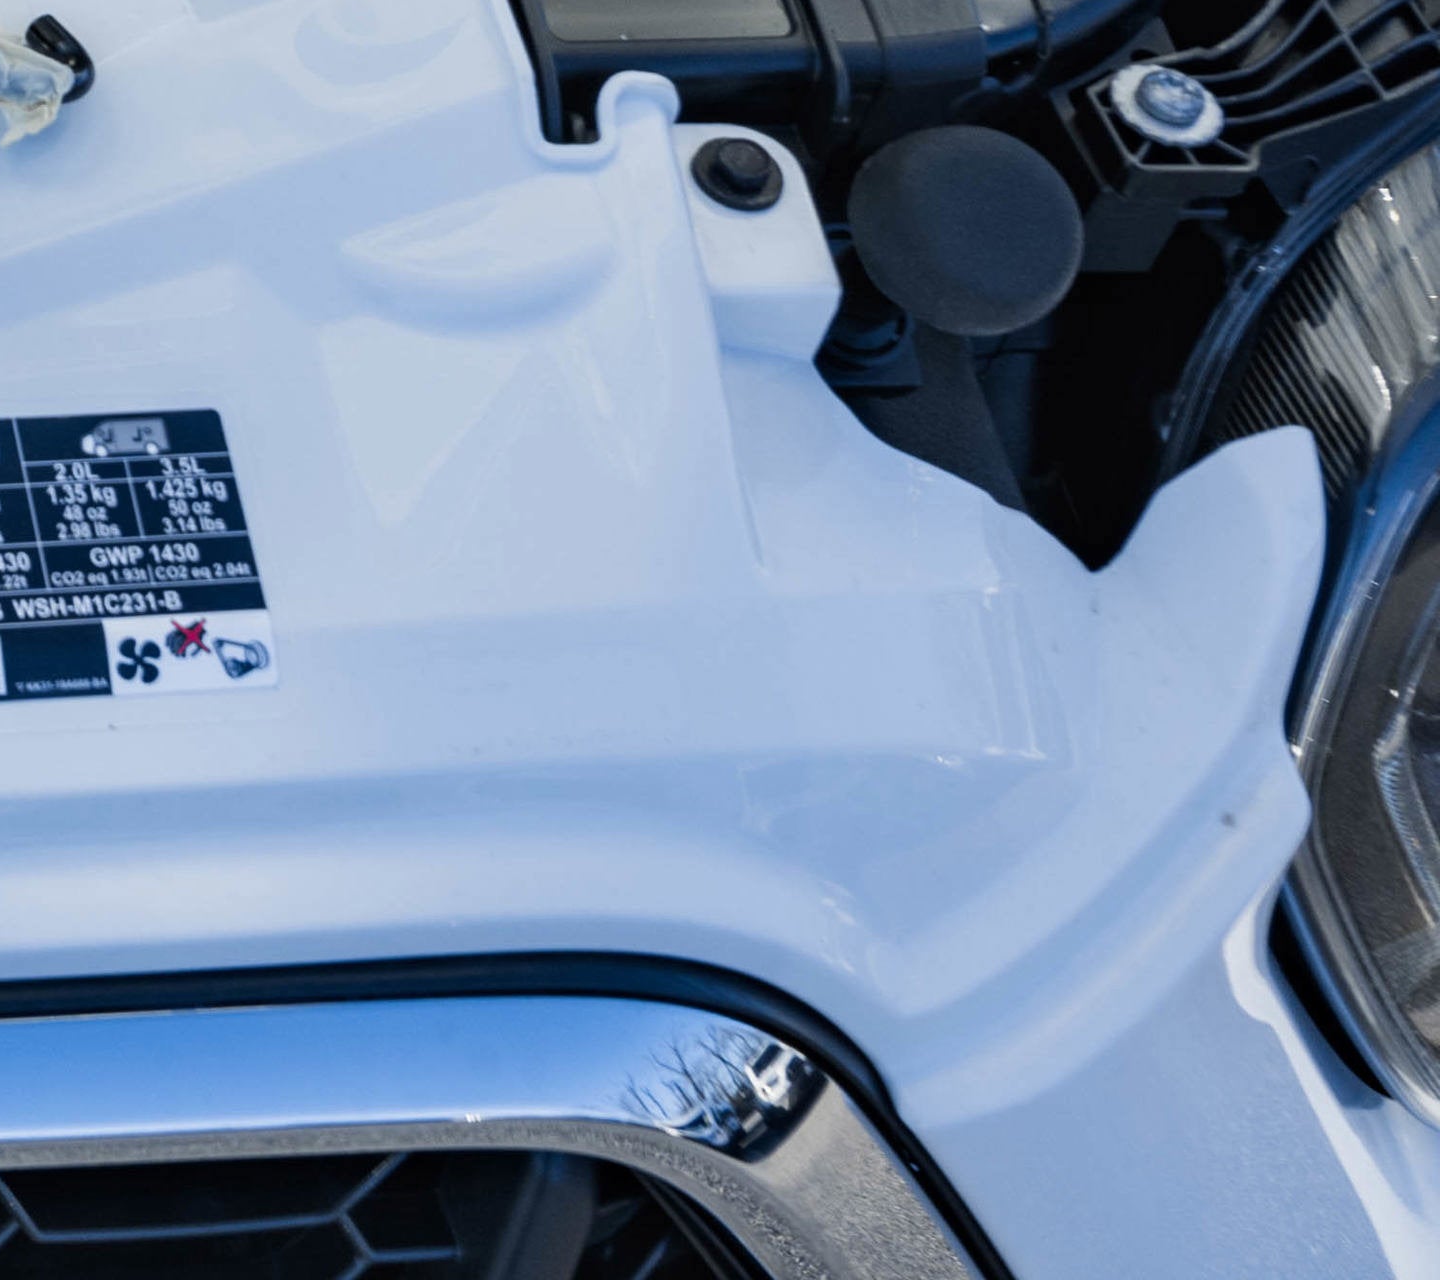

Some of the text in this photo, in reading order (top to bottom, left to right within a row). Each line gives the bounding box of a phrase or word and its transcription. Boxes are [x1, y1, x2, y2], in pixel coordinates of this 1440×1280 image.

[53, 461, 100, 481] 2.0L
[159, 456, 206, 476] 3.5L
[46, 483, 118, 508] 1.35 kg
[145, 478, 229, 502] 1.425 kg
[86, 507, 109, 521] oz
[168, 499, 214, 517] 50 oz
[94, 521, 122, 538] lbs
[162, 515, 227, 534] 3.14 lbs
[89, 542, 200, 568] GWP 1430
[50, 571, 85, 586] CO2
[88, 572, 109, 586] eq
[154, 564, 189, 580] CO2
[191, 566, 212, 581] eq
[12, 590, 182, 620] WSH-M1C231-B
